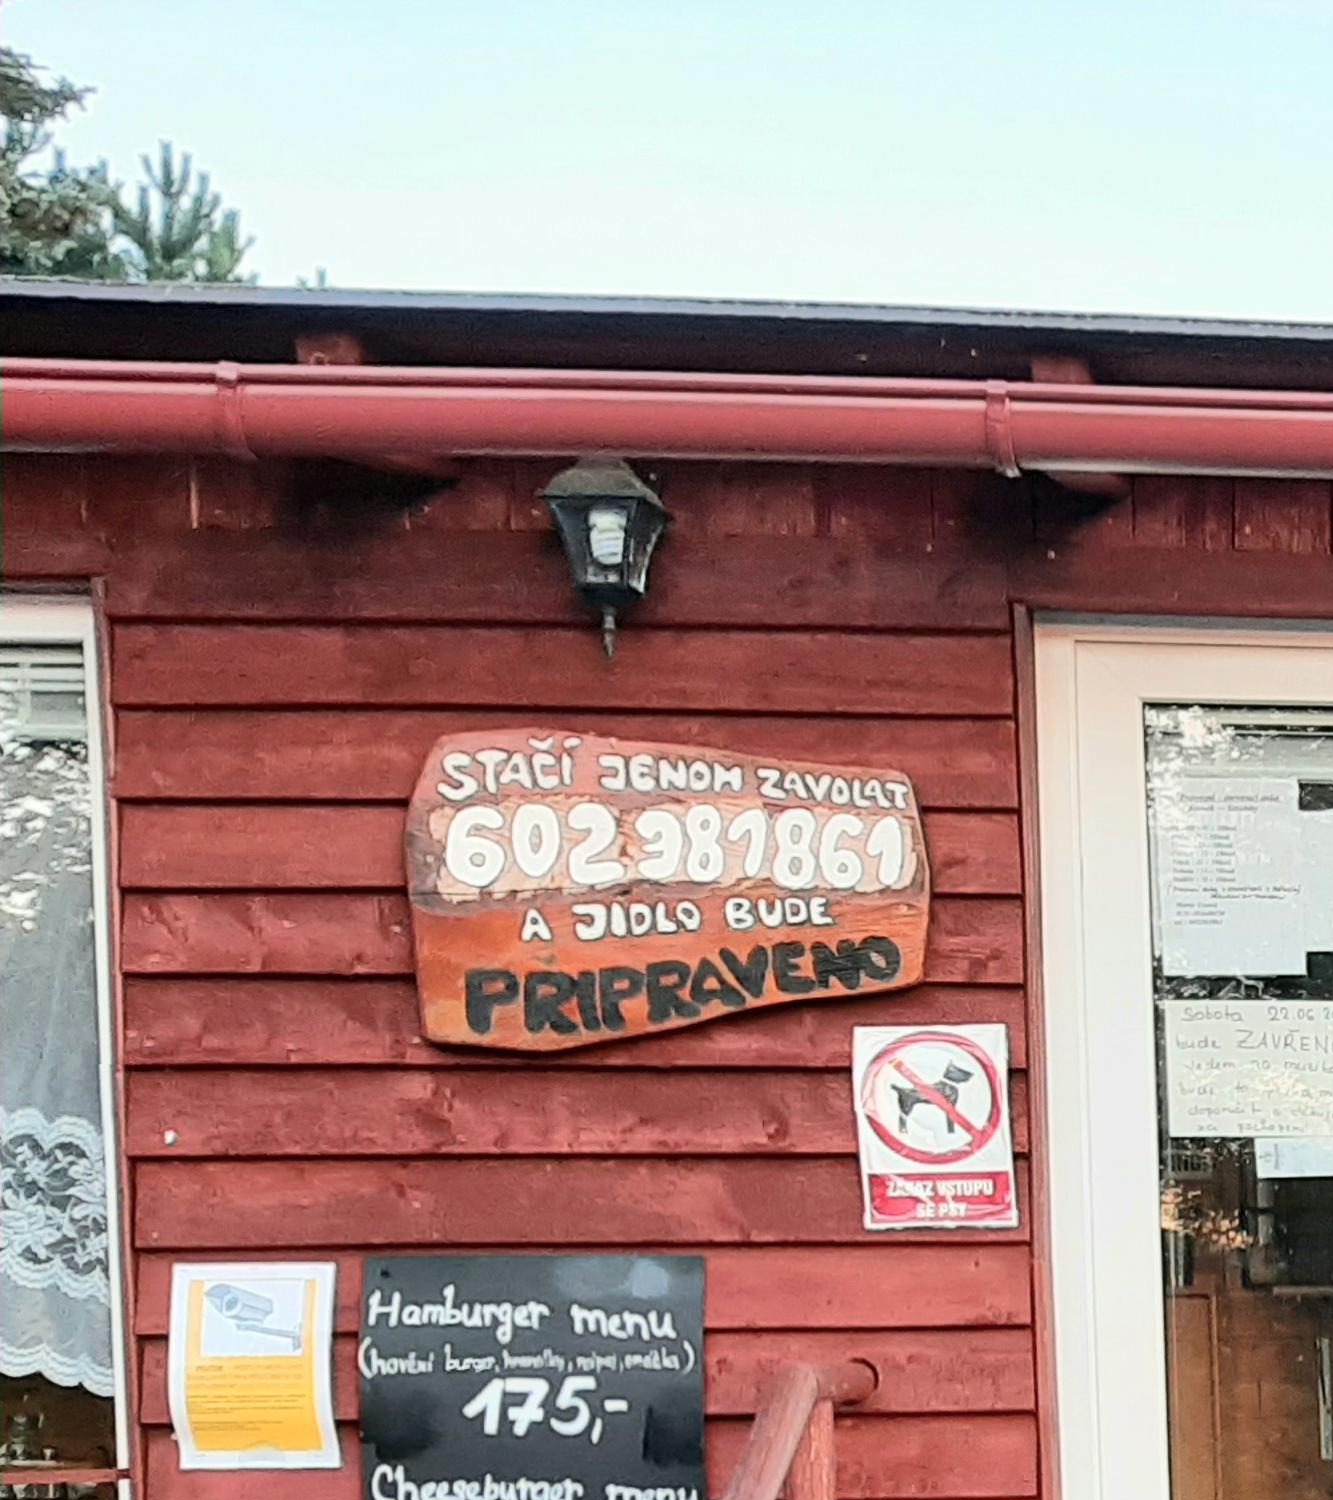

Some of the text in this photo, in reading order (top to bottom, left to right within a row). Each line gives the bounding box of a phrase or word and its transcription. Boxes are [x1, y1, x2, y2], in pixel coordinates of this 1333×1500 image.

[438, 737, 909, 809] STAČÍ JENOM ZAVOLAT
[520, 897, 834, 942] A JIDLO BUDE
[464, 935, 902, 1035] PRIPRAVENO
[1180, 1006, 1244, 1022] Sobota
[937, 1179, 994, 1196] VSTUPU
[917, 1203, 968, 1218] SE PSY
[368, 1284, 677, 1344] Hamburger menu
